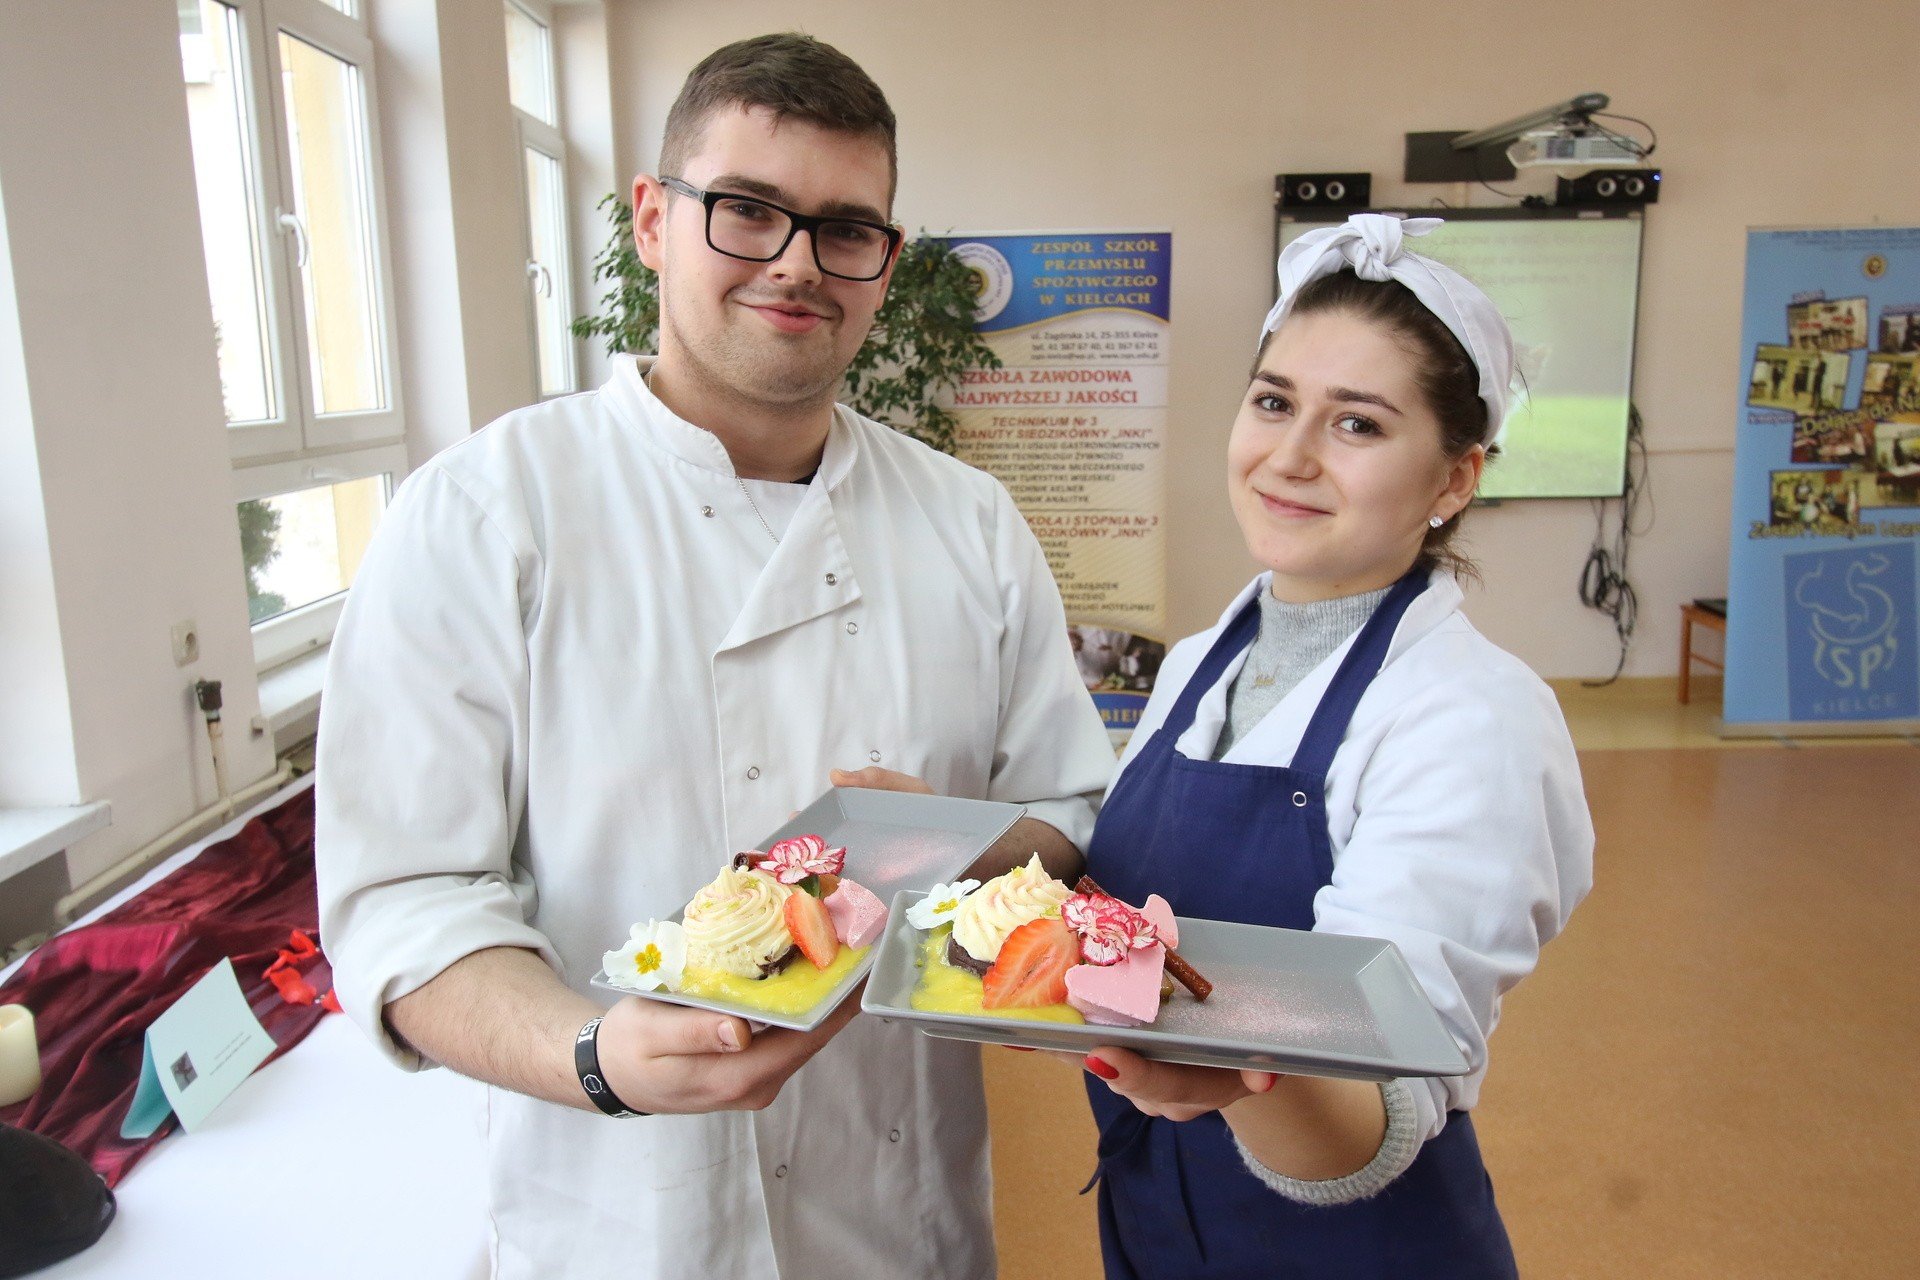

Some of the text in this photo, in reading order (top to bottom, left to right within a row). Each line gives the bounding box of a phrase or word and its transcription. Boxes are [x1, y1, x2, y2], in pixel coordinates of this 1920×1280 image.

[1032, 239, 1159, 254] ZESPÓŁ SZKÓŁ
[1044, 258, 1146, 271] PRZEMYSŁU
[1032, 275, 1158, 288] SPOŻYWCZEGO
[1040, 292, 1151, 305] W KIELCACH
[960, 370, 1132, 385] SZKOŁA ZAWODOWA
[953, 389, 1138, 405] NAJWYŻSZEJ JAKOŚCI
[992, 416, 1098, 427] TECHNIKUM Nr 3
[958, 429, 1012, 440] DANUTY
[1017, 427, 1110, 440] SIEDZIKÓWNY
